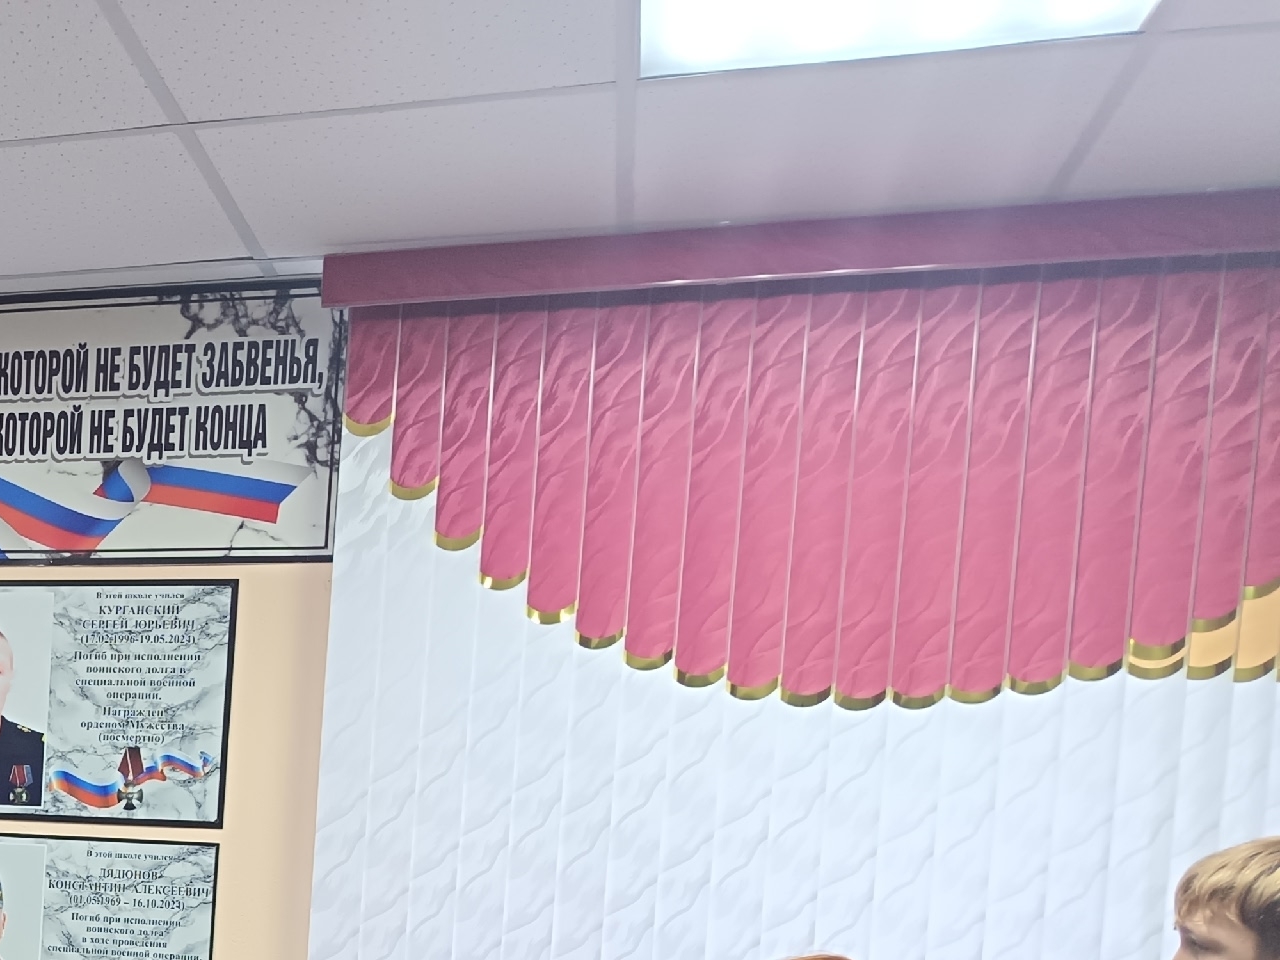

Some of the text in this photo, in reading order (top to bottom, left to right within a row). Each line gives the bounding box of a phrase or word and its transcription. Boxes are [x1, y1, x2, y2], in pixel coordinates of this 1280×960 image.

[95, 348, 122, 392] НЕ
[128, 344, 196, 396] БУДЕТ
[201, 338, 323, 389] ЗАБВЕНЬЯ,
[89, 410, 114, 453] НЕ
[121, 407, 189, 458] БУДЕТ
[194, 404, 267, 455] КОНЦА
[98, 603, 180, 615] КУРГАНСКИЙ
[82, 617, 195, 630] СЕРГЕЙ ЮРЬЕВИЧ
[73, 651, 201, 662] Погиб при исполнении
[86, 666, 142, 674] воинского
[145, 666, 175, 675] долга
[75, 678, 196, 687] специальной военной
[102, 706, 164, 717] Награжден
[80, 720, 184, 731] орденом Мужества
[98, 733, 165, 744] (посмертно)
[94, 850, 112, 858] этой
[99, 868, 158, 880] ДЯДЮНОВ
[48, 879, 210, 897] КОНСТАНТИН АЛЕКСЕЕВИЧ
[71, 912, 181, 927] Погиб при исполнении
[86, 925, 165, 938] воинского долга
[89, 937, 109, 945] ходе
[112, 938, 167, 949] проведения
[47, 945, 108, 956] специальной
[111, 949, 150, 958] военной
